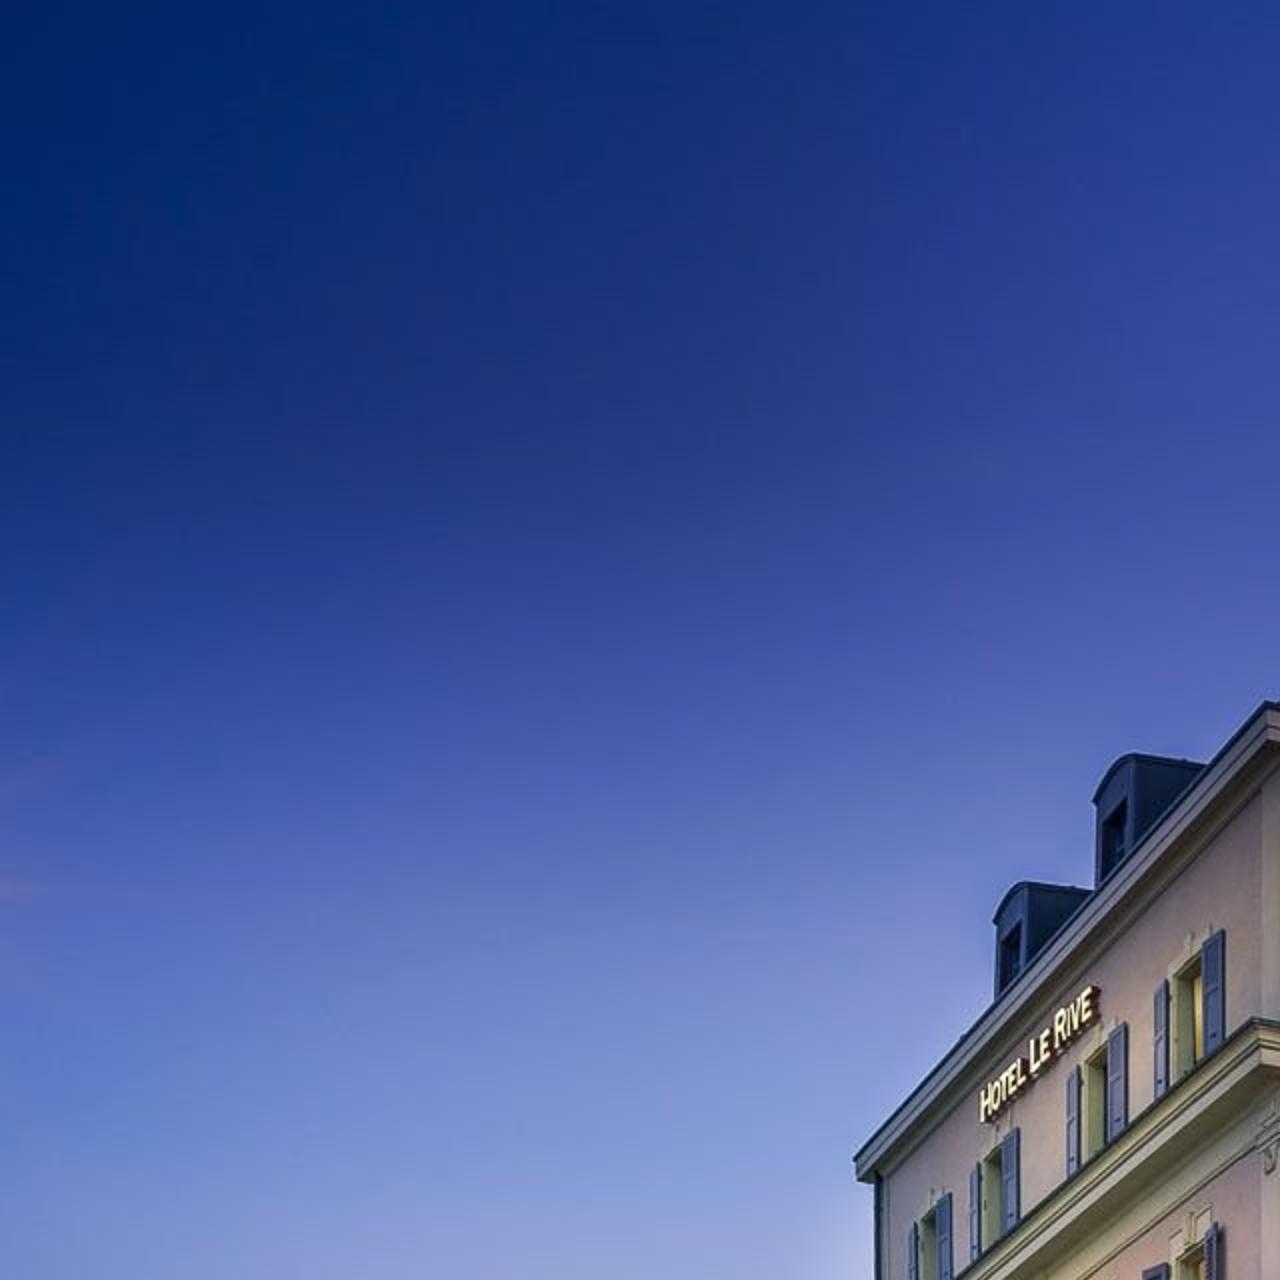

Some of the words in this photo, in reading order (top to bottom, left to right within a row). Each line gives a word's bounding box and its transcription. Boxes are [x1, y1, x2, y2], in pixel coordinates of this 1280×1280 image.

[979, 1057, 1027, 1123] HOTEL
[1029, 1027, 1051, 1074] LE
[1053, 985, 1093, 1049] RIVE
